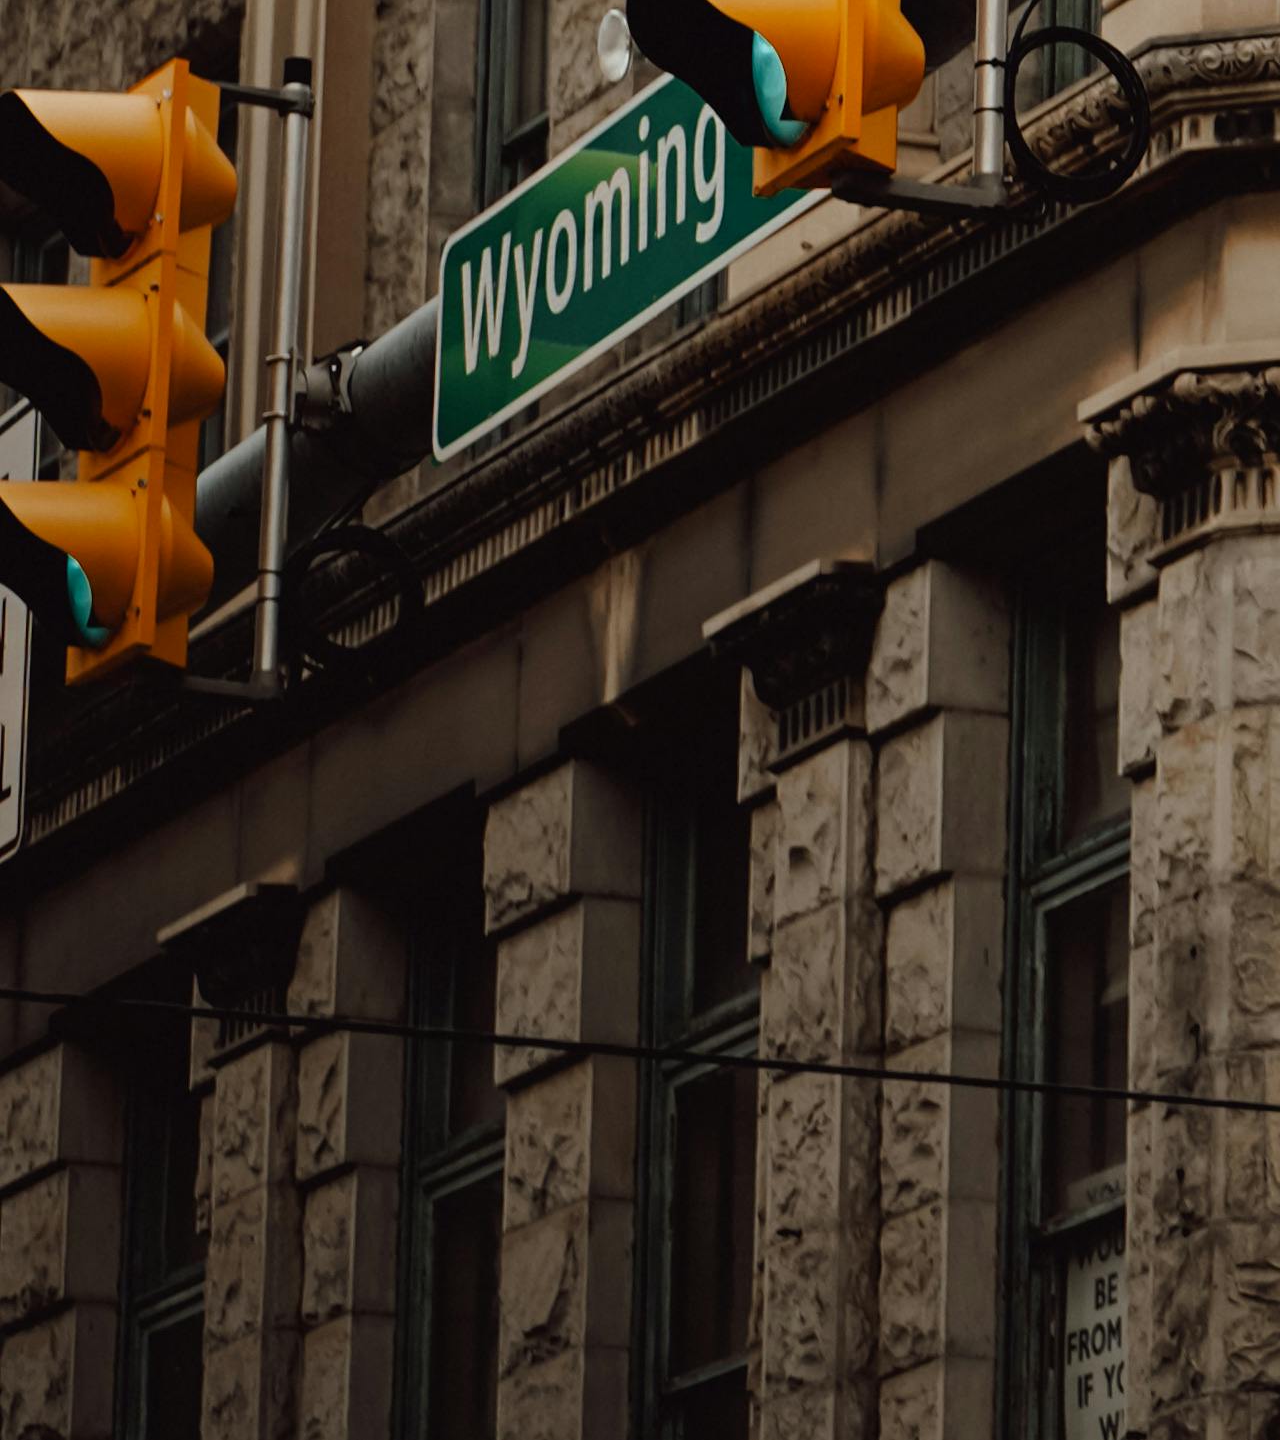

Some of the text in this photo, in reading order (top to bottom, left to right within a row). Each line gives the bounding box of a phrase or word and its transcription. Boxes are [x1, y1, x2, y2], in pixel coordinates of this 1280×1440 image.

[460, 102, 727, 380] Wyoming
[1066, 1315, 1123, 1366] FROM
[1077, 1371, 1094, 1410] IF
